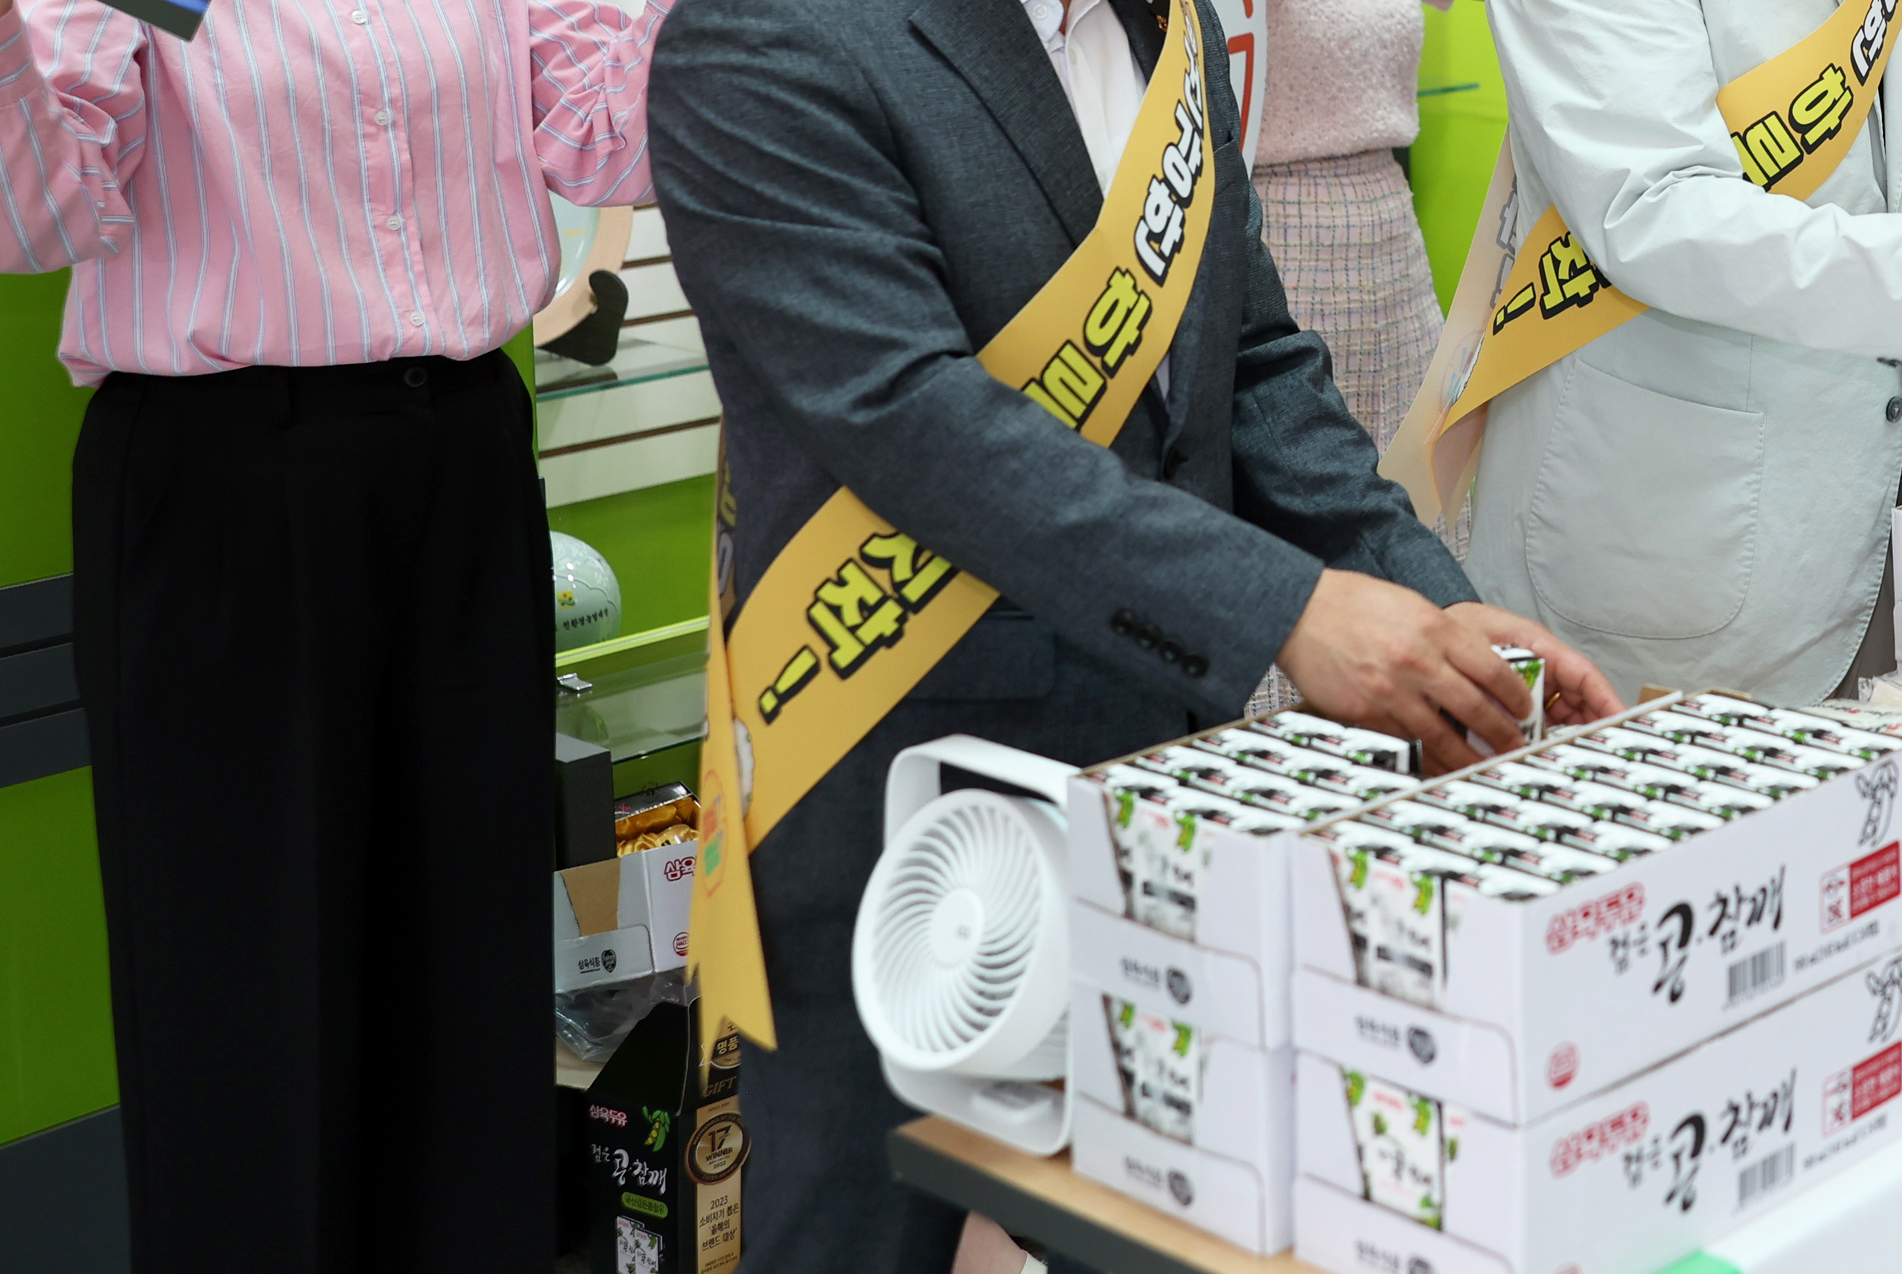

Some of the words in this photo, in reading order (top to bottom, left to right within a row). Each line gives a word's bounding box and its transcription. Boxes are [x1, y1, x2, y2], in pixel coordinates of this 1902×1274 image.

[708, 1125, 732, 1153] 17
[706, 1146, 734, 1163] WINNER
[711, 1195, 729, 1210] 2023
